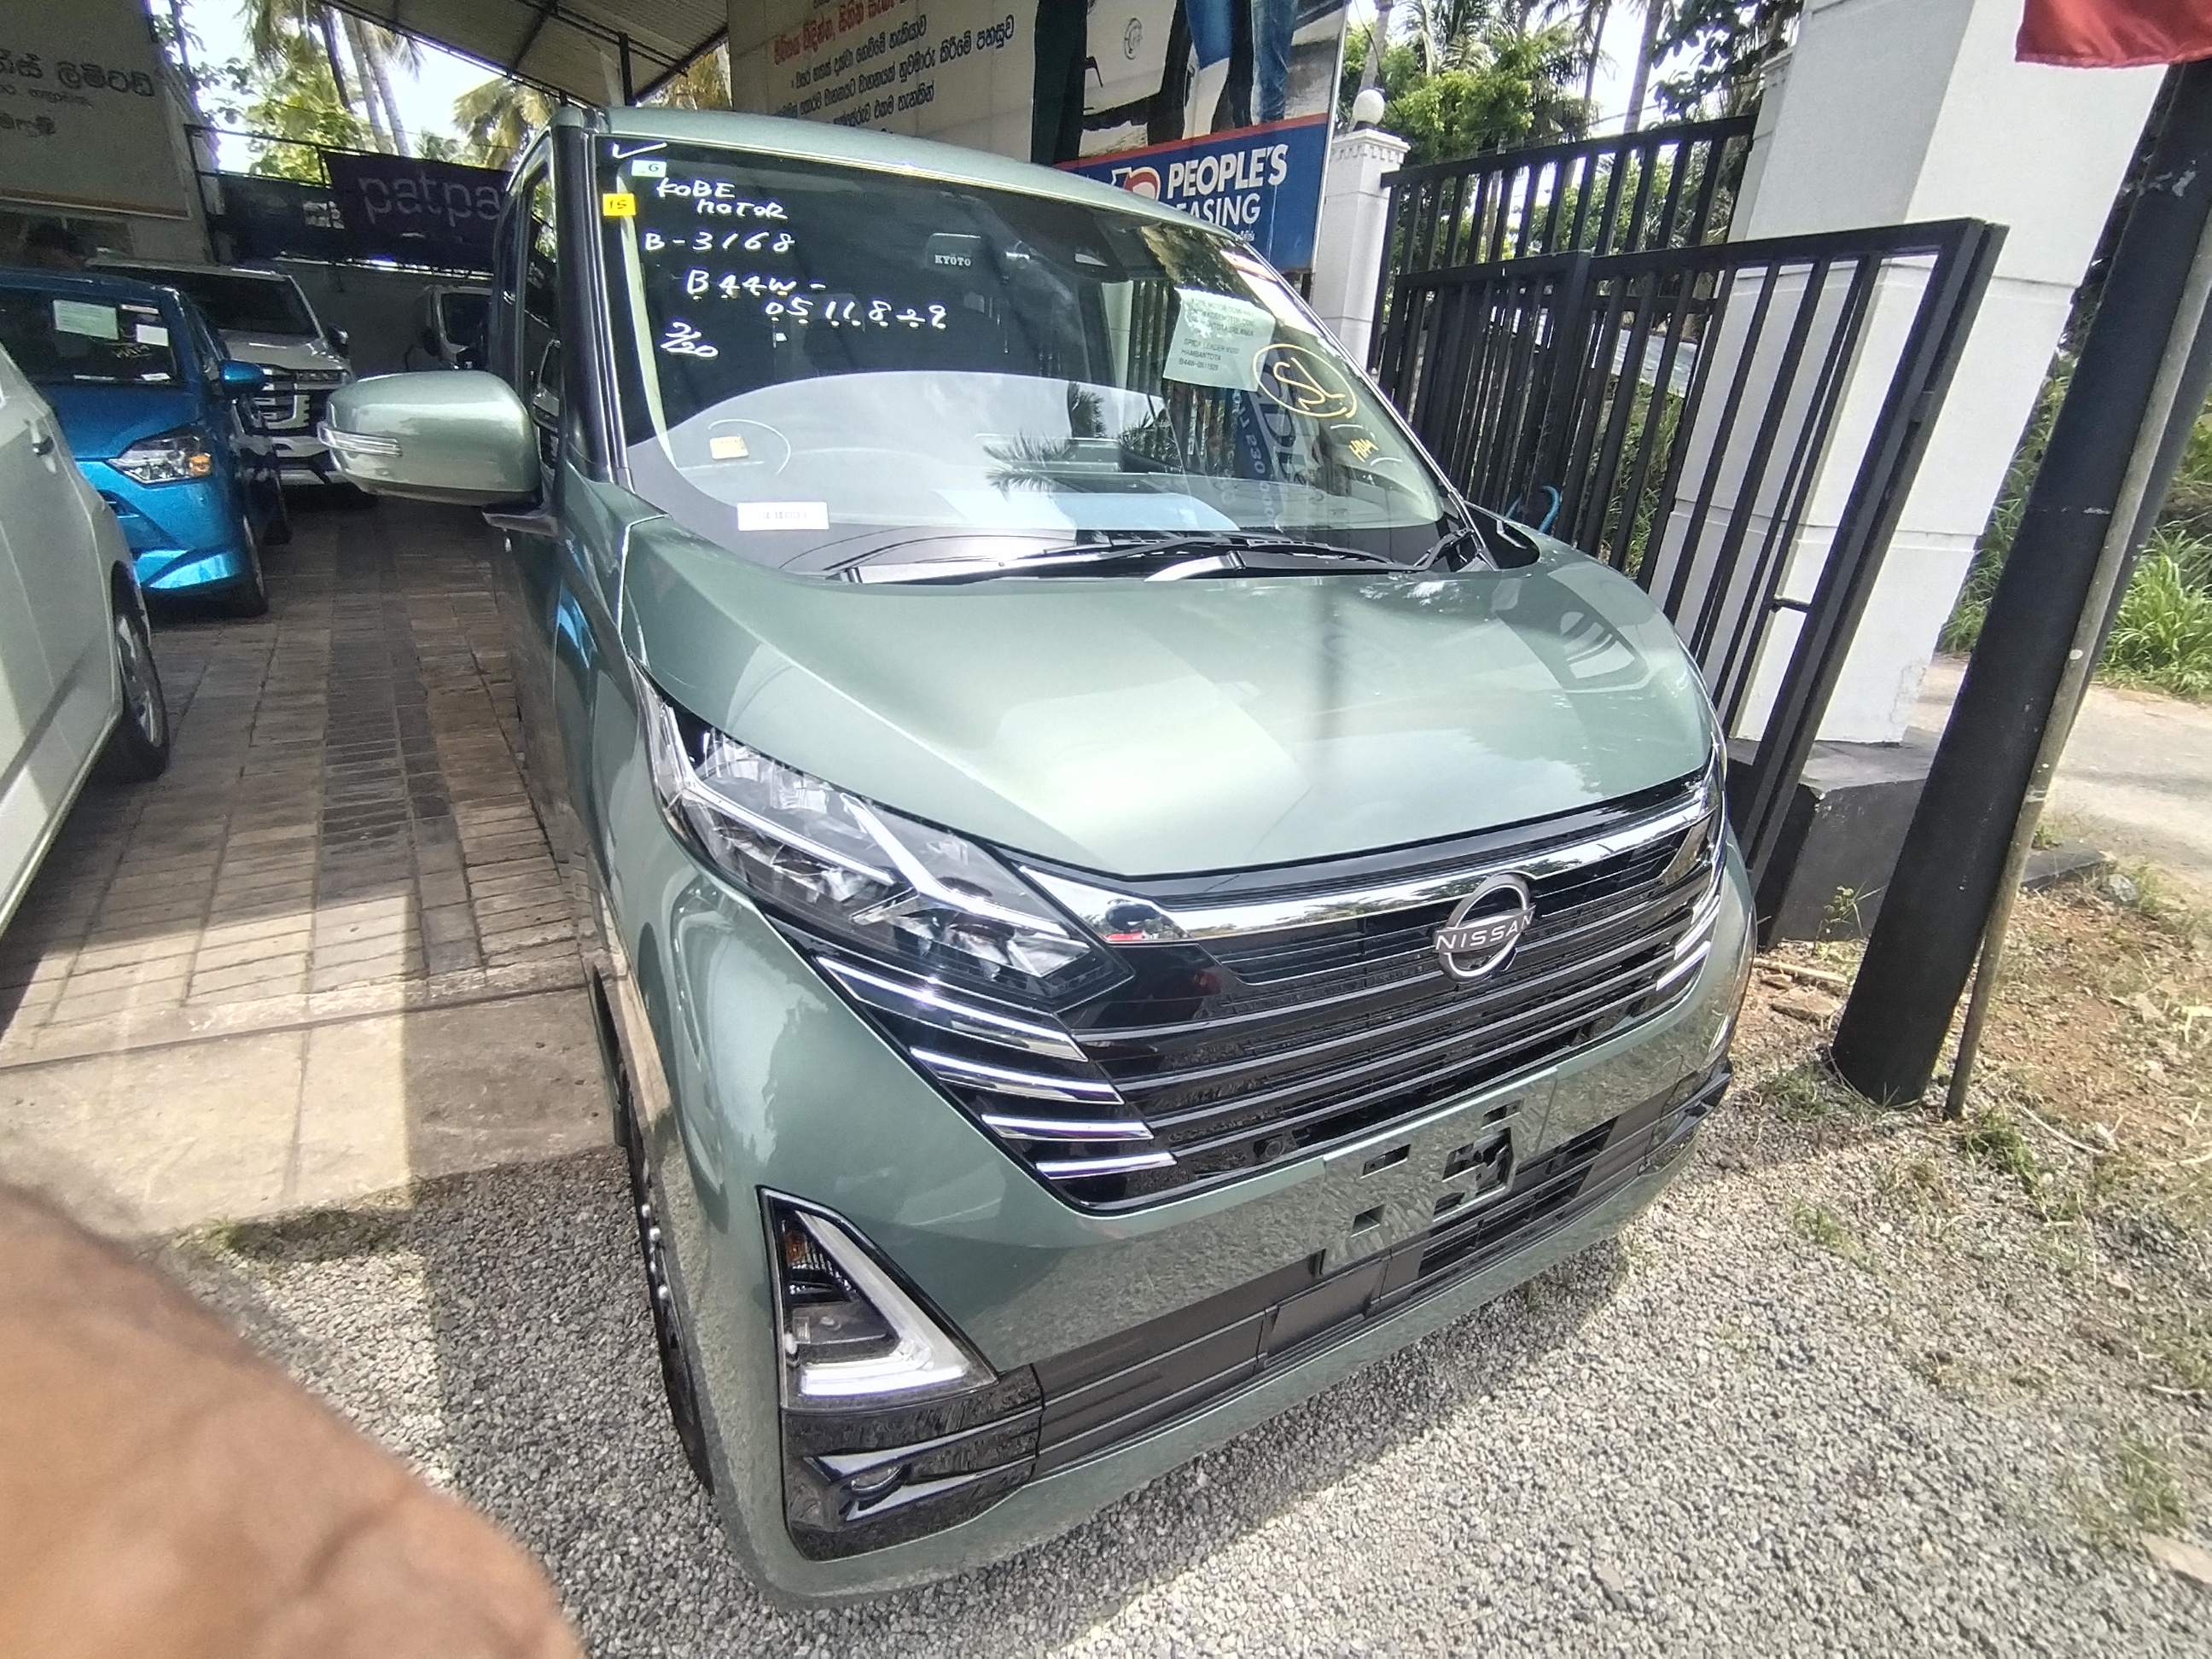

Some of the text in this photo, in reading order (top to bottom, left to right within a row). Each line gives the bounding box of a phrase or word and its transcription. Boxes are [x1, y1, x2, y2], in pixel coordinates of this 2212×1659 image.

[976, 14, 1015, 49] පහසුව
[1167, 143, 1289, 200] PEOPLE'S
[357, 170, 506, 228] patpa
[1435, 911, 1534, 951] NISSAN
